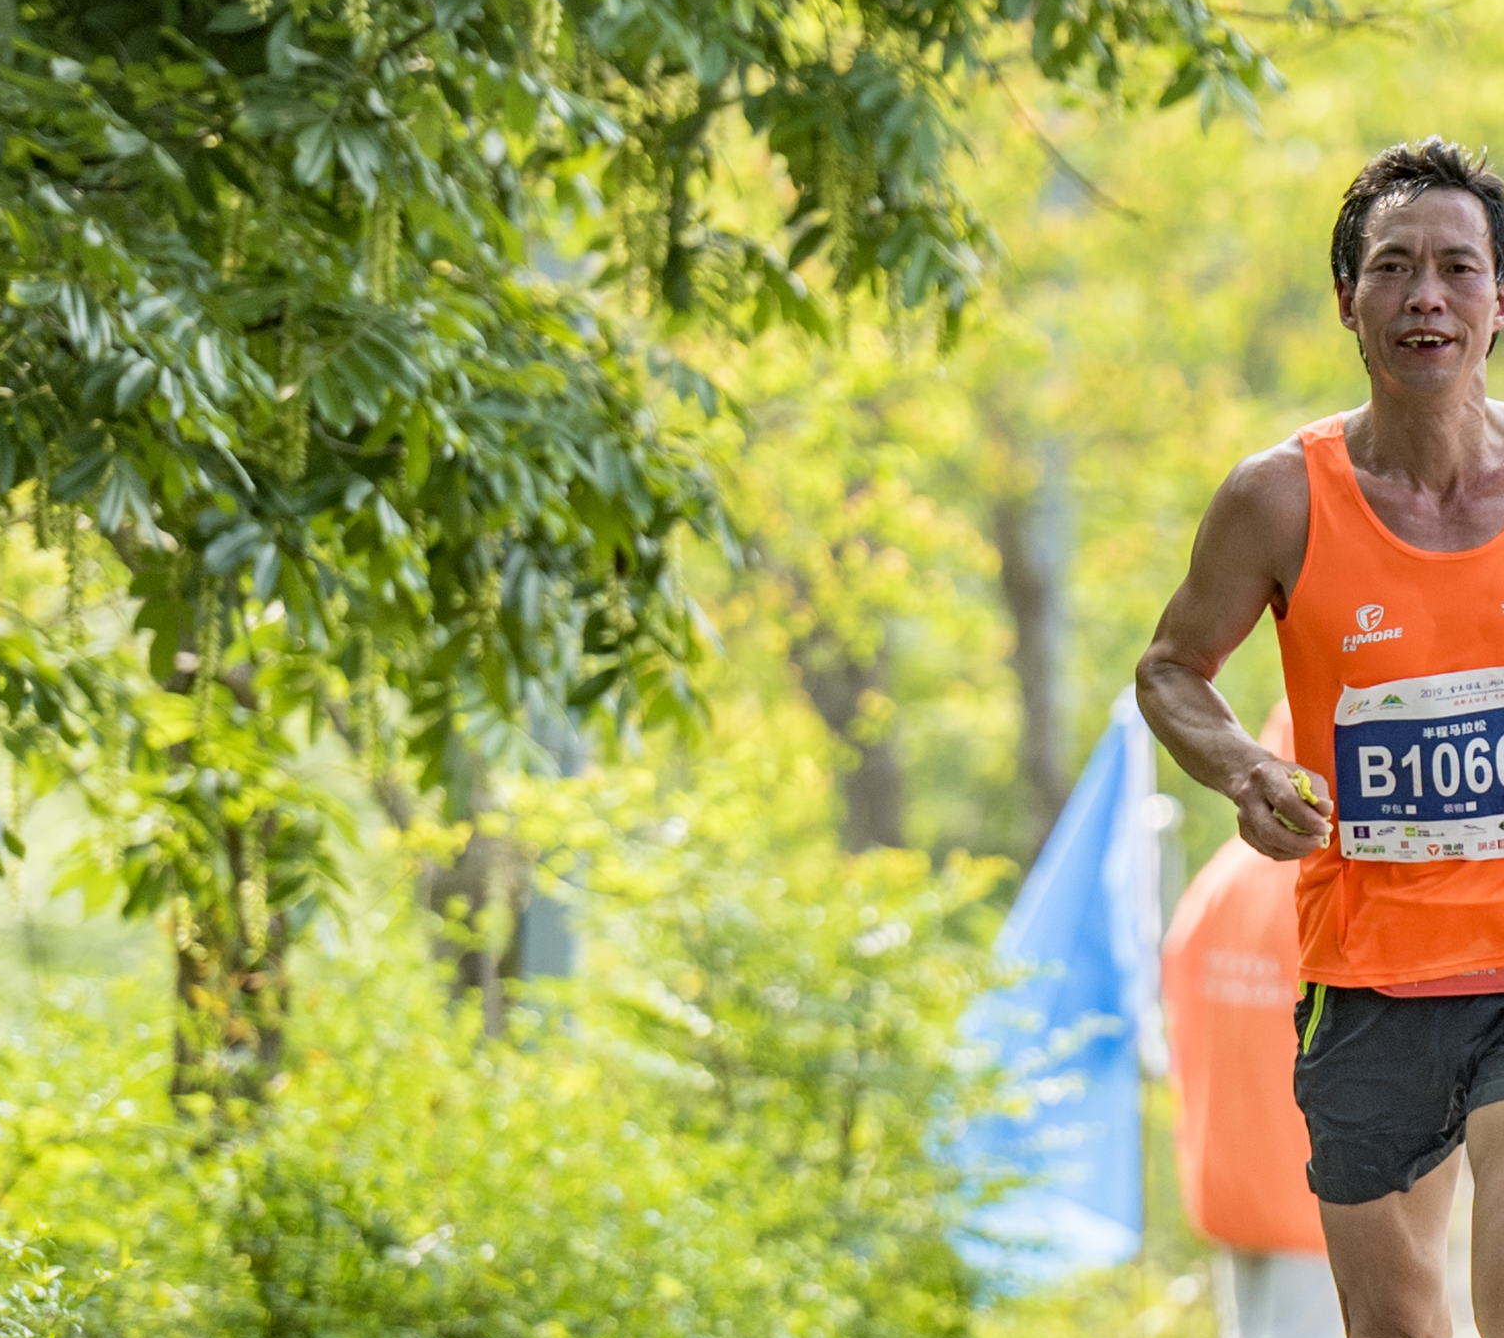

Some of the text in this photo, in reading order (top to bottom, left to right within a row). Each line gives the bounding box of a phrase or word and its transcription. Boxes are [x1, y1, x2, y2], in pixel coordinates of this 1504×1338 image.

[1420, 687, 1443, 698] 2019
[1422, 719, 1487, 740] 半程马拉松
